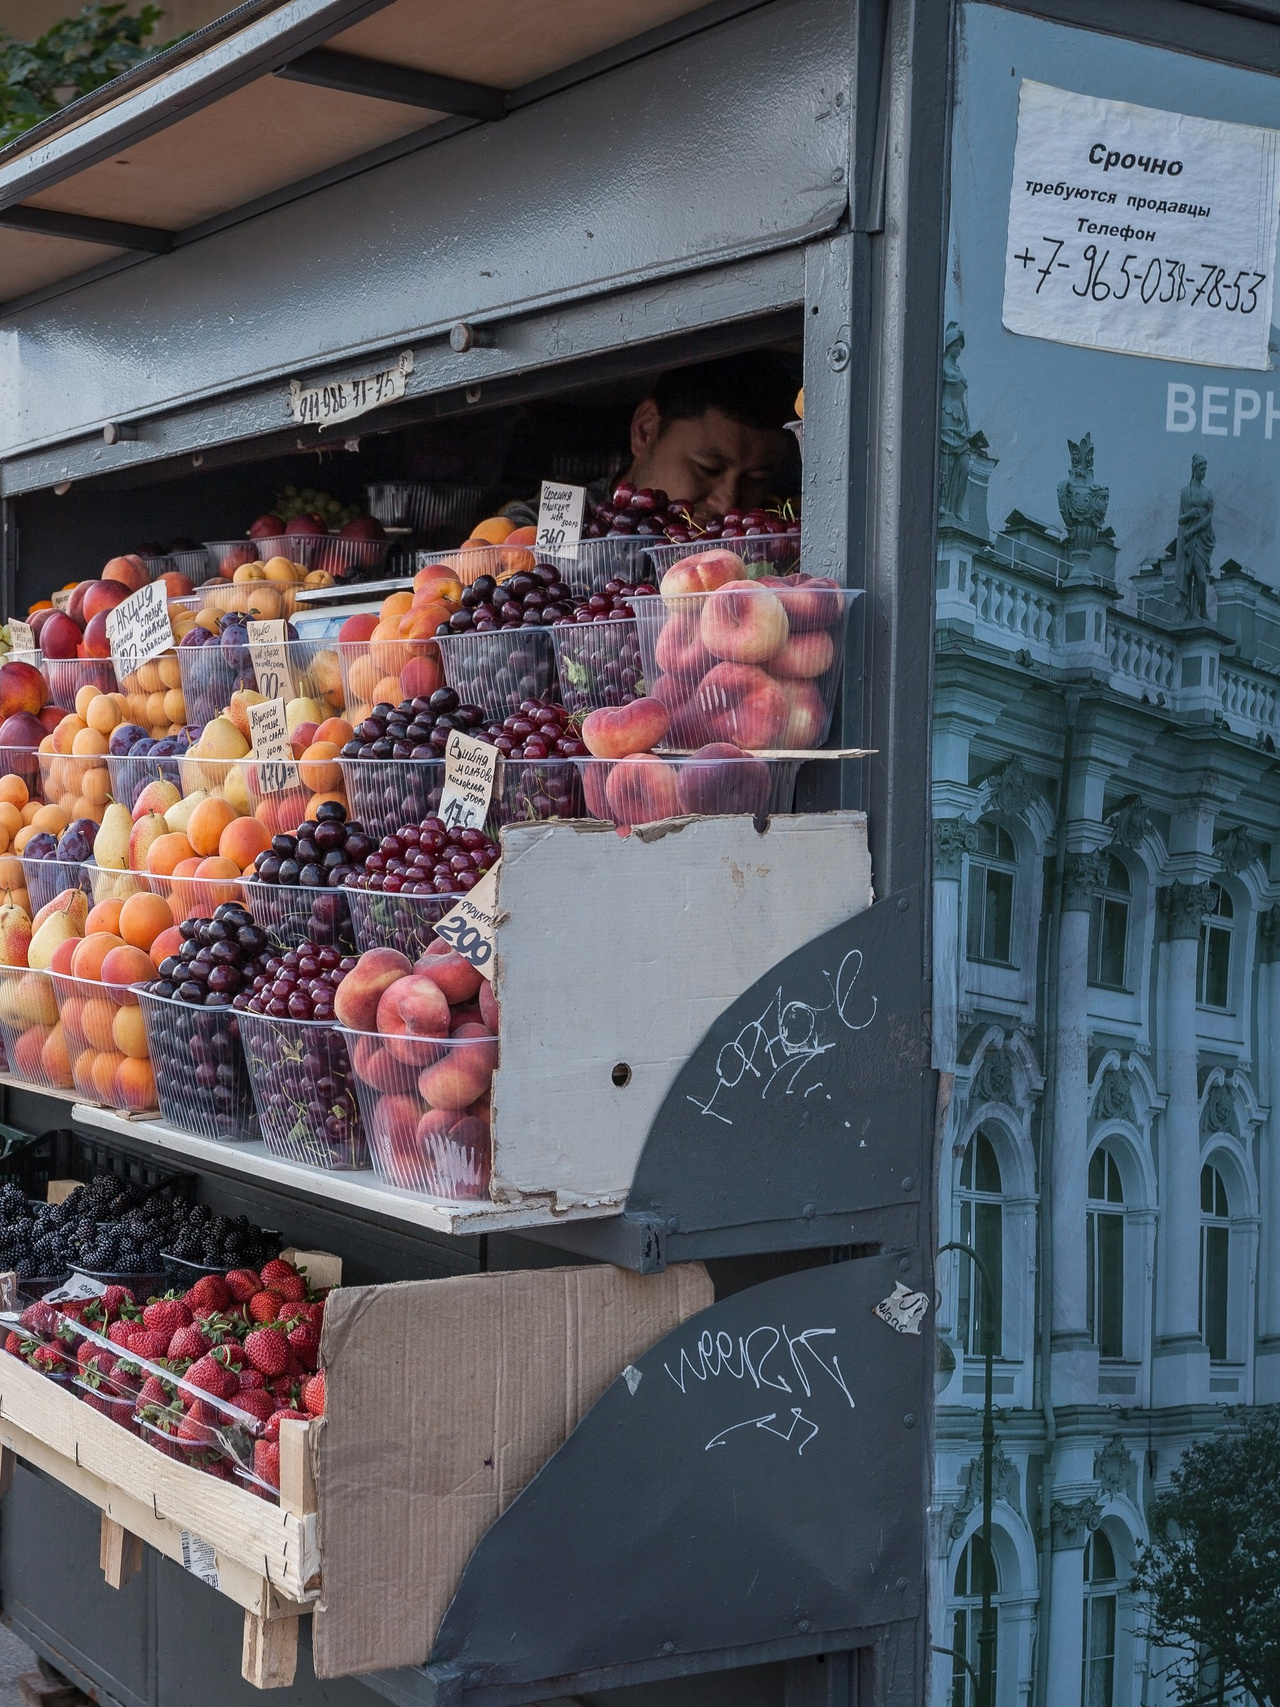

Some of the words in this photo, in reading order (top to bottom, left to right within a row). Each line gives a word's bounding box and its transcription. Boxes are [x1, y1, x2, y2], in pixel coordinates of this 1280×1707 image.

[1088, 143, 1184, 177] Срочно
[1025, 180, 1117, 204] требуются
[1126, 195, 1211, 218] продавцы
[1077, 217, 1156, 242] Телефон
[116, 585, 153, 635] АКЦИЯ
[449, 737, 489, 768] Вишня
